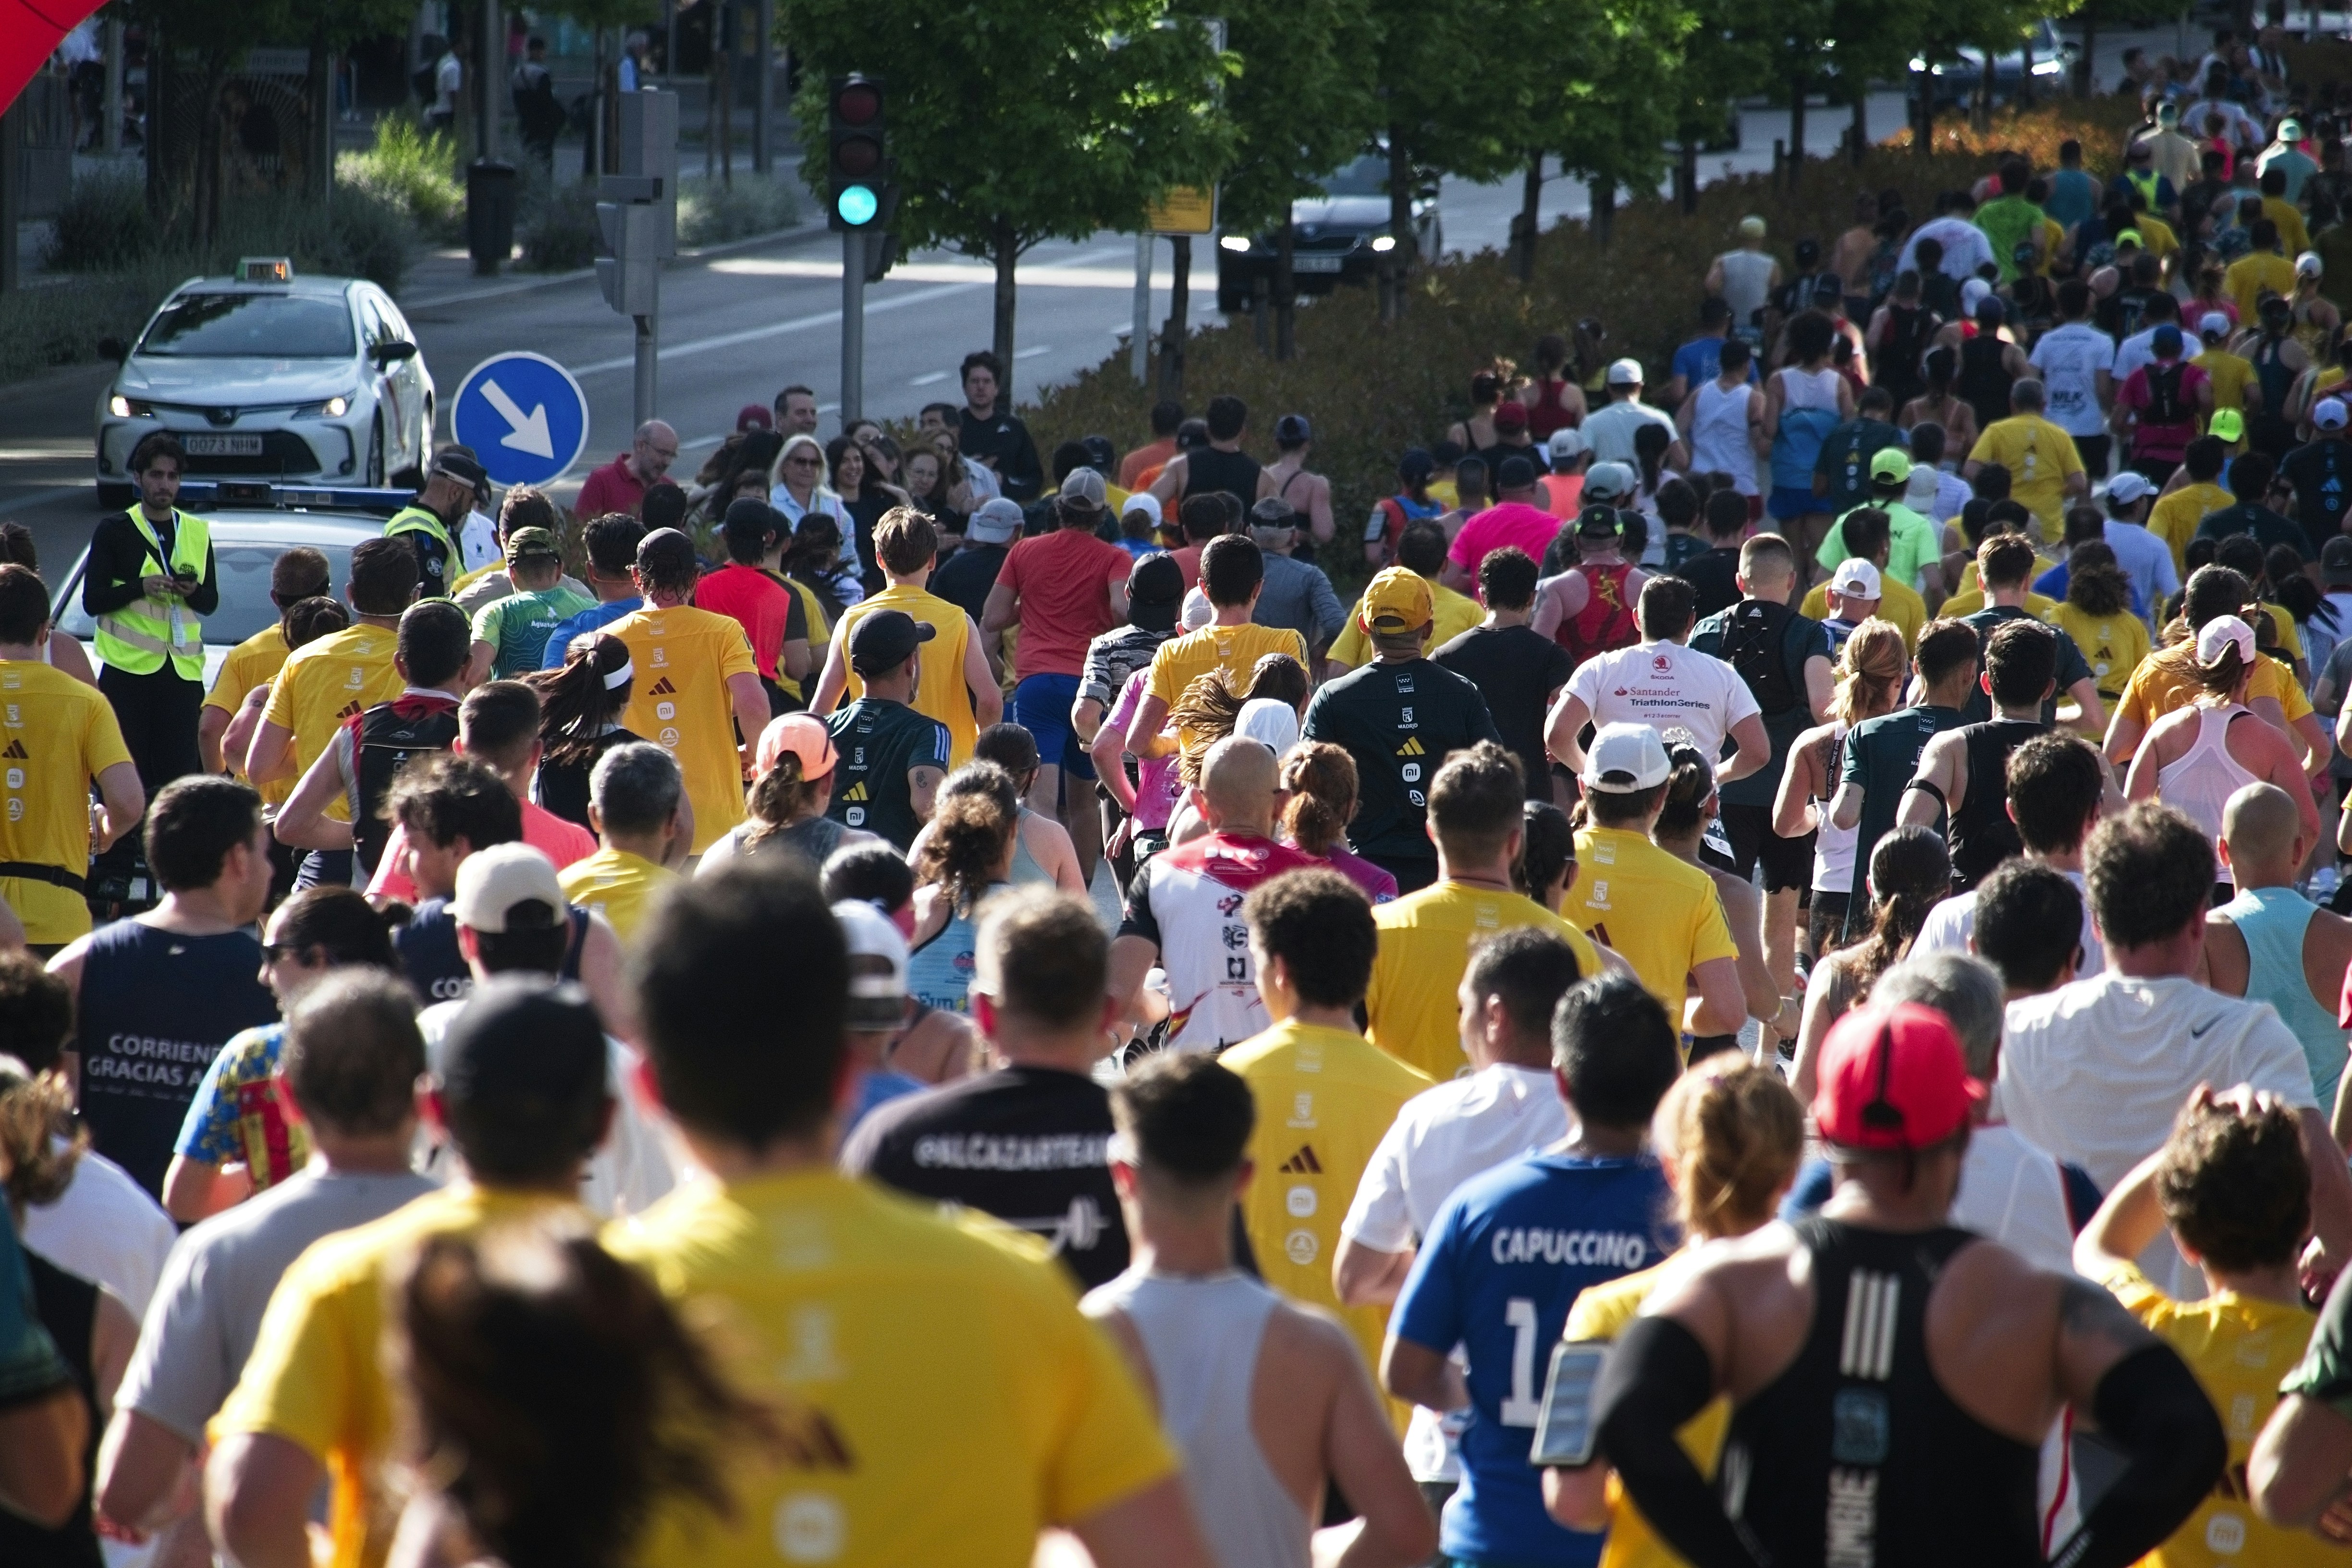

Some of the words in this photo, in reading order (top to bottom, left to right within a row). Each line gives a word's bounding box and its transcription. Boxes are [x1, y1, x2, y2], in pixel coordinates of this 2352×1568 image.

[1630, 686, 1680, 697] Santander
[1630, 699, 1710, 710] TriathlonSeries
[87, 1055, 184, 1086] GRACIAS
[1491, 1227, 1646, 1270] CAPUCCINO
